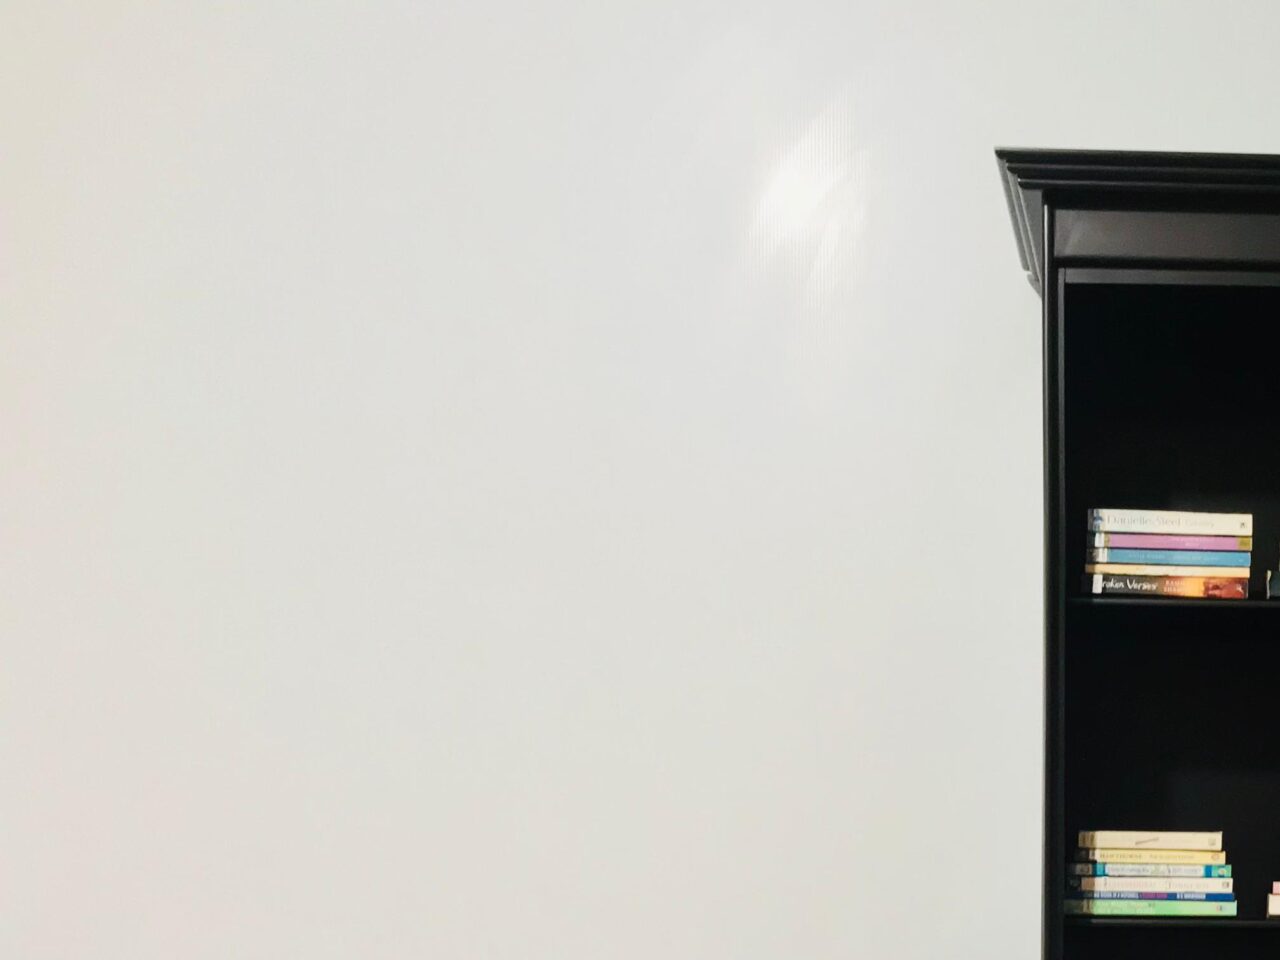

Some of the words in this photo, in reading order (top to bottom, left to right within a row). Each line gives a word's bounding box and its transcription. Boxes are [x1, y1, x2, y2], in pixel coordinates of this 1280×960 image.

[1107, 515, 1151, 526] Danielle
[1155, 516, 1181, 527] Steel
[1099, 578, 1124, 589] roken
